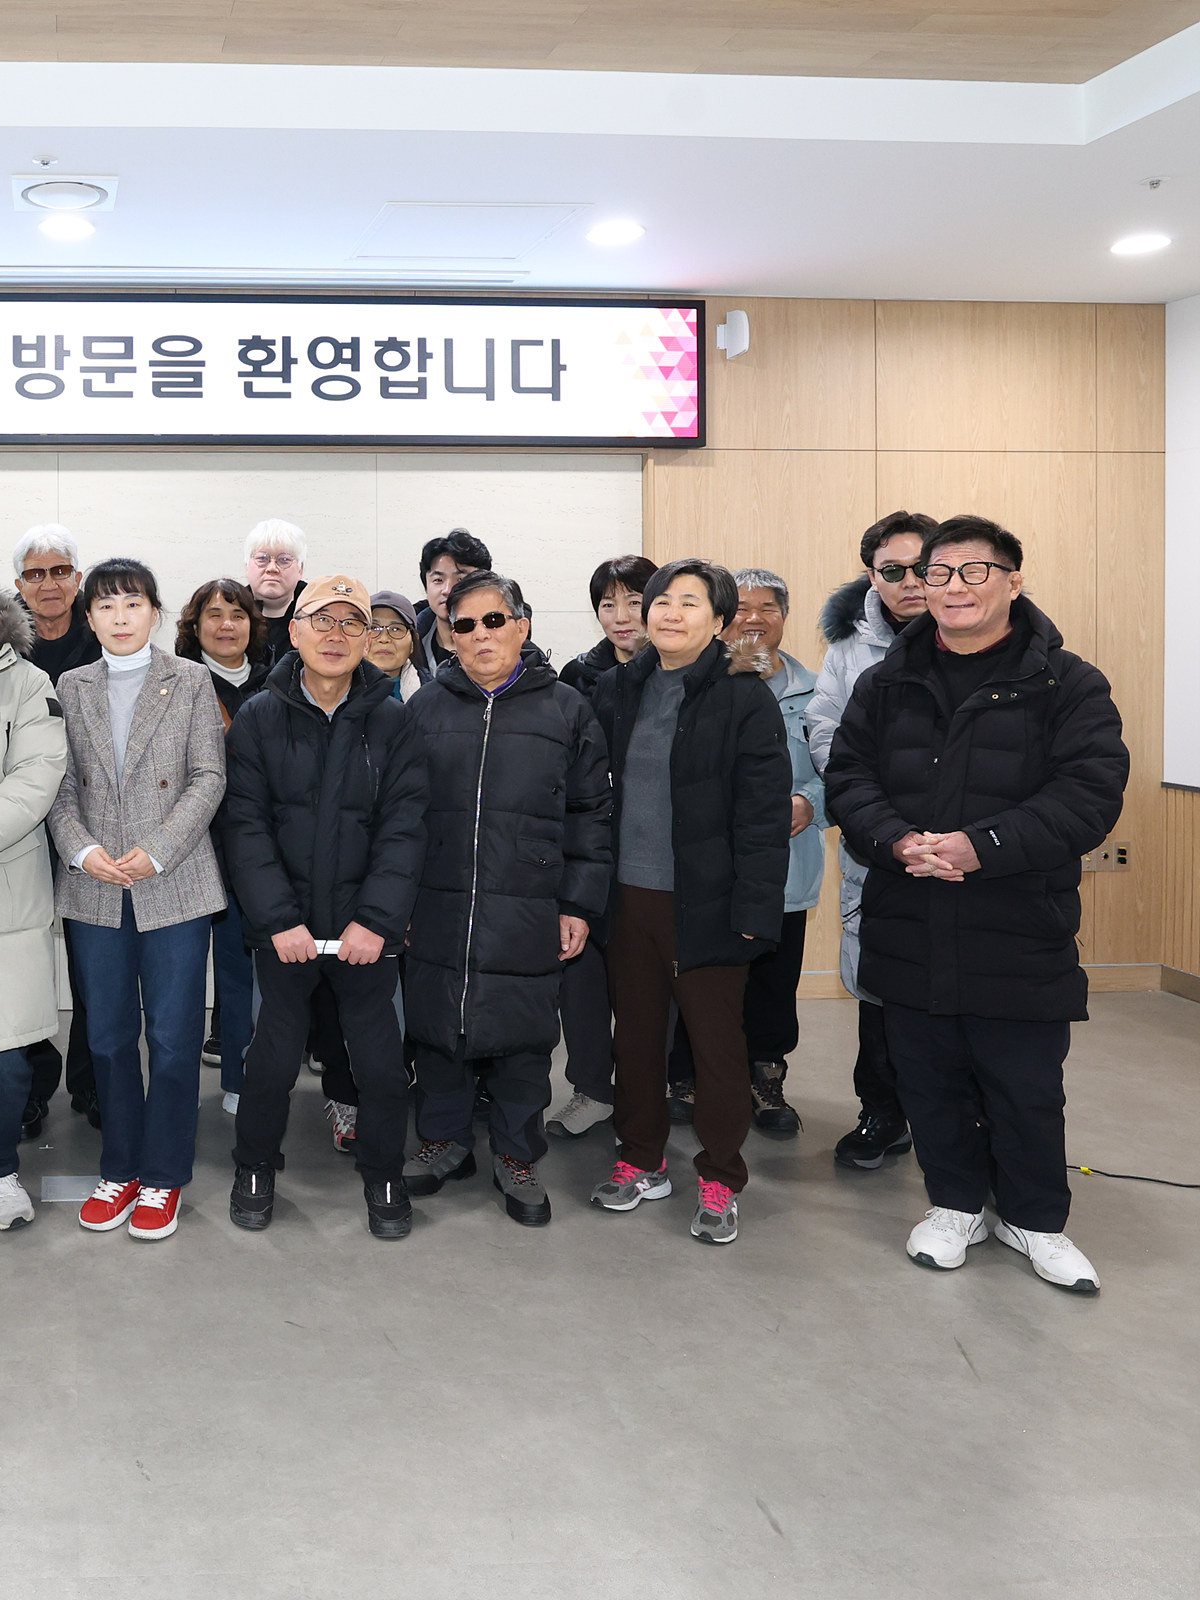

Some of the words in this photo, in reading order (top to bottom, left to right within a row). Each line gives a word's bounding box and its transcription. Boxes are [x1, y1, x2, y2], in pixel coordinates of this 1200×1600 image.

[13, 334, 206, 401] 방문을
[238, 334, 567, 402] 환영합니다
[635, 1178, 651, 1194] N
